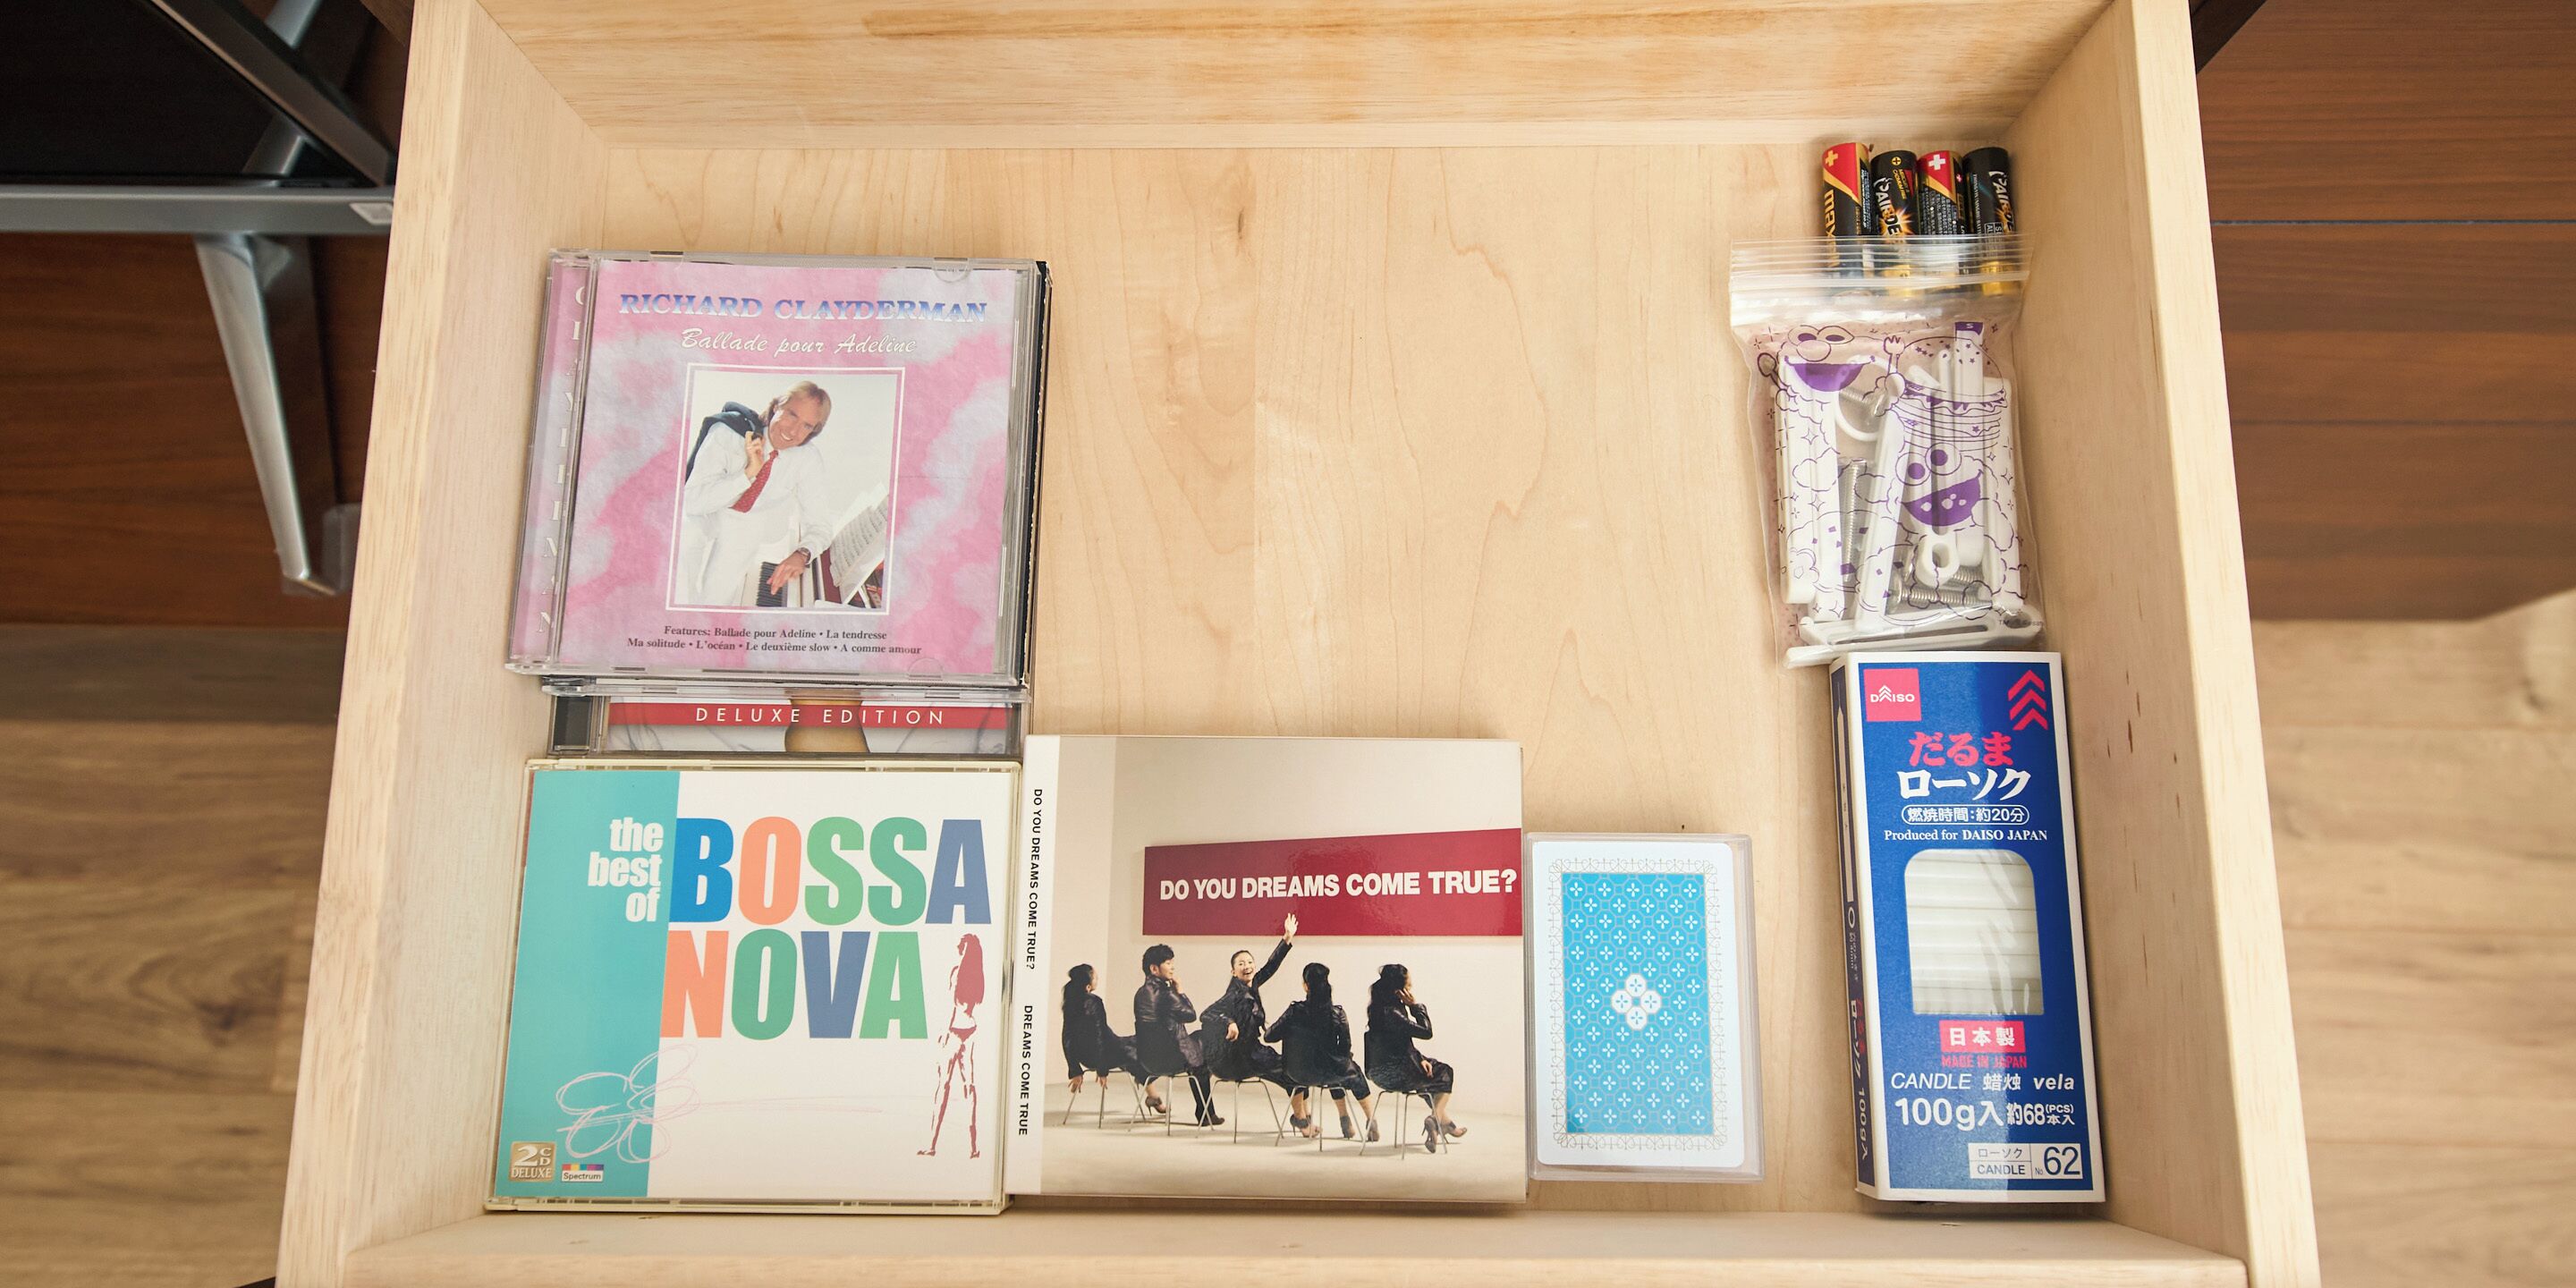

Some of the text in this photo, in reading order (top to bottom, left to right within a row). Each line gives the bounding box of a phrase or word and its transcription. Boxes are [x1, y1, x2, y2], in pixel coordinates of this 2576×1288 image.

[619, 293, 987, 323] RICHARD CLAYDERMAN
[681, 327, 918, 358] Ballade pour Adeline
[664, 624, 887, 641] Features: Ballade pour Adeline La tendresse
[627, 638, 922, 656] Ma solitude L'océan Le deuxième slow A comme amour
[1870, 685, 1914, 702] DAISO
[695, 708, 945, 724] DELUXE EDITION
[1909, 731, 2013, 767] だるま
[1897, 768, 2031, 801] ローソク
[1907, 808, 2026, 822] 燃焼時間：約20分
[610, 818, 664, 852] the
[1884, 830, 2047, 841] Produced for DAISO JAPAN
[588, 852, 662, 887] best
[669, 817, 991, 925] BOSSA
[1025, 788, 1044, 970] DO YOU DREAMS COME TRUE?
[1159, 869, 1517, 901] DO YOU DREAMS COME TRUE?
[624, 886, 661, 922] of
[660, 928, 928, 1040] NOVA
[1950, 1027, 2015, 1046] 日本製
[1018, 1005, 1033, 1136] DREAMS COME TRUE
[1942, 1054, 2027, 1068] MADE IN JAPAN
[1891, 1072, 1971, 1089] CANDLE
[2034, 1073, 2075, 1090] vela
[2046, 1104, 2074, 1114] (PCS)
[514, 1144, 538, 1166] 2
[1977, 1165, 2026, 1175] CANDLE
[2044, 1147, 2080, 1175] 62
[1978, 1148, 2023, 1158] ローソク
[512, 1167, 552, 1179] DELUXE
[564, 1173, 601, 1181] Spectrum
